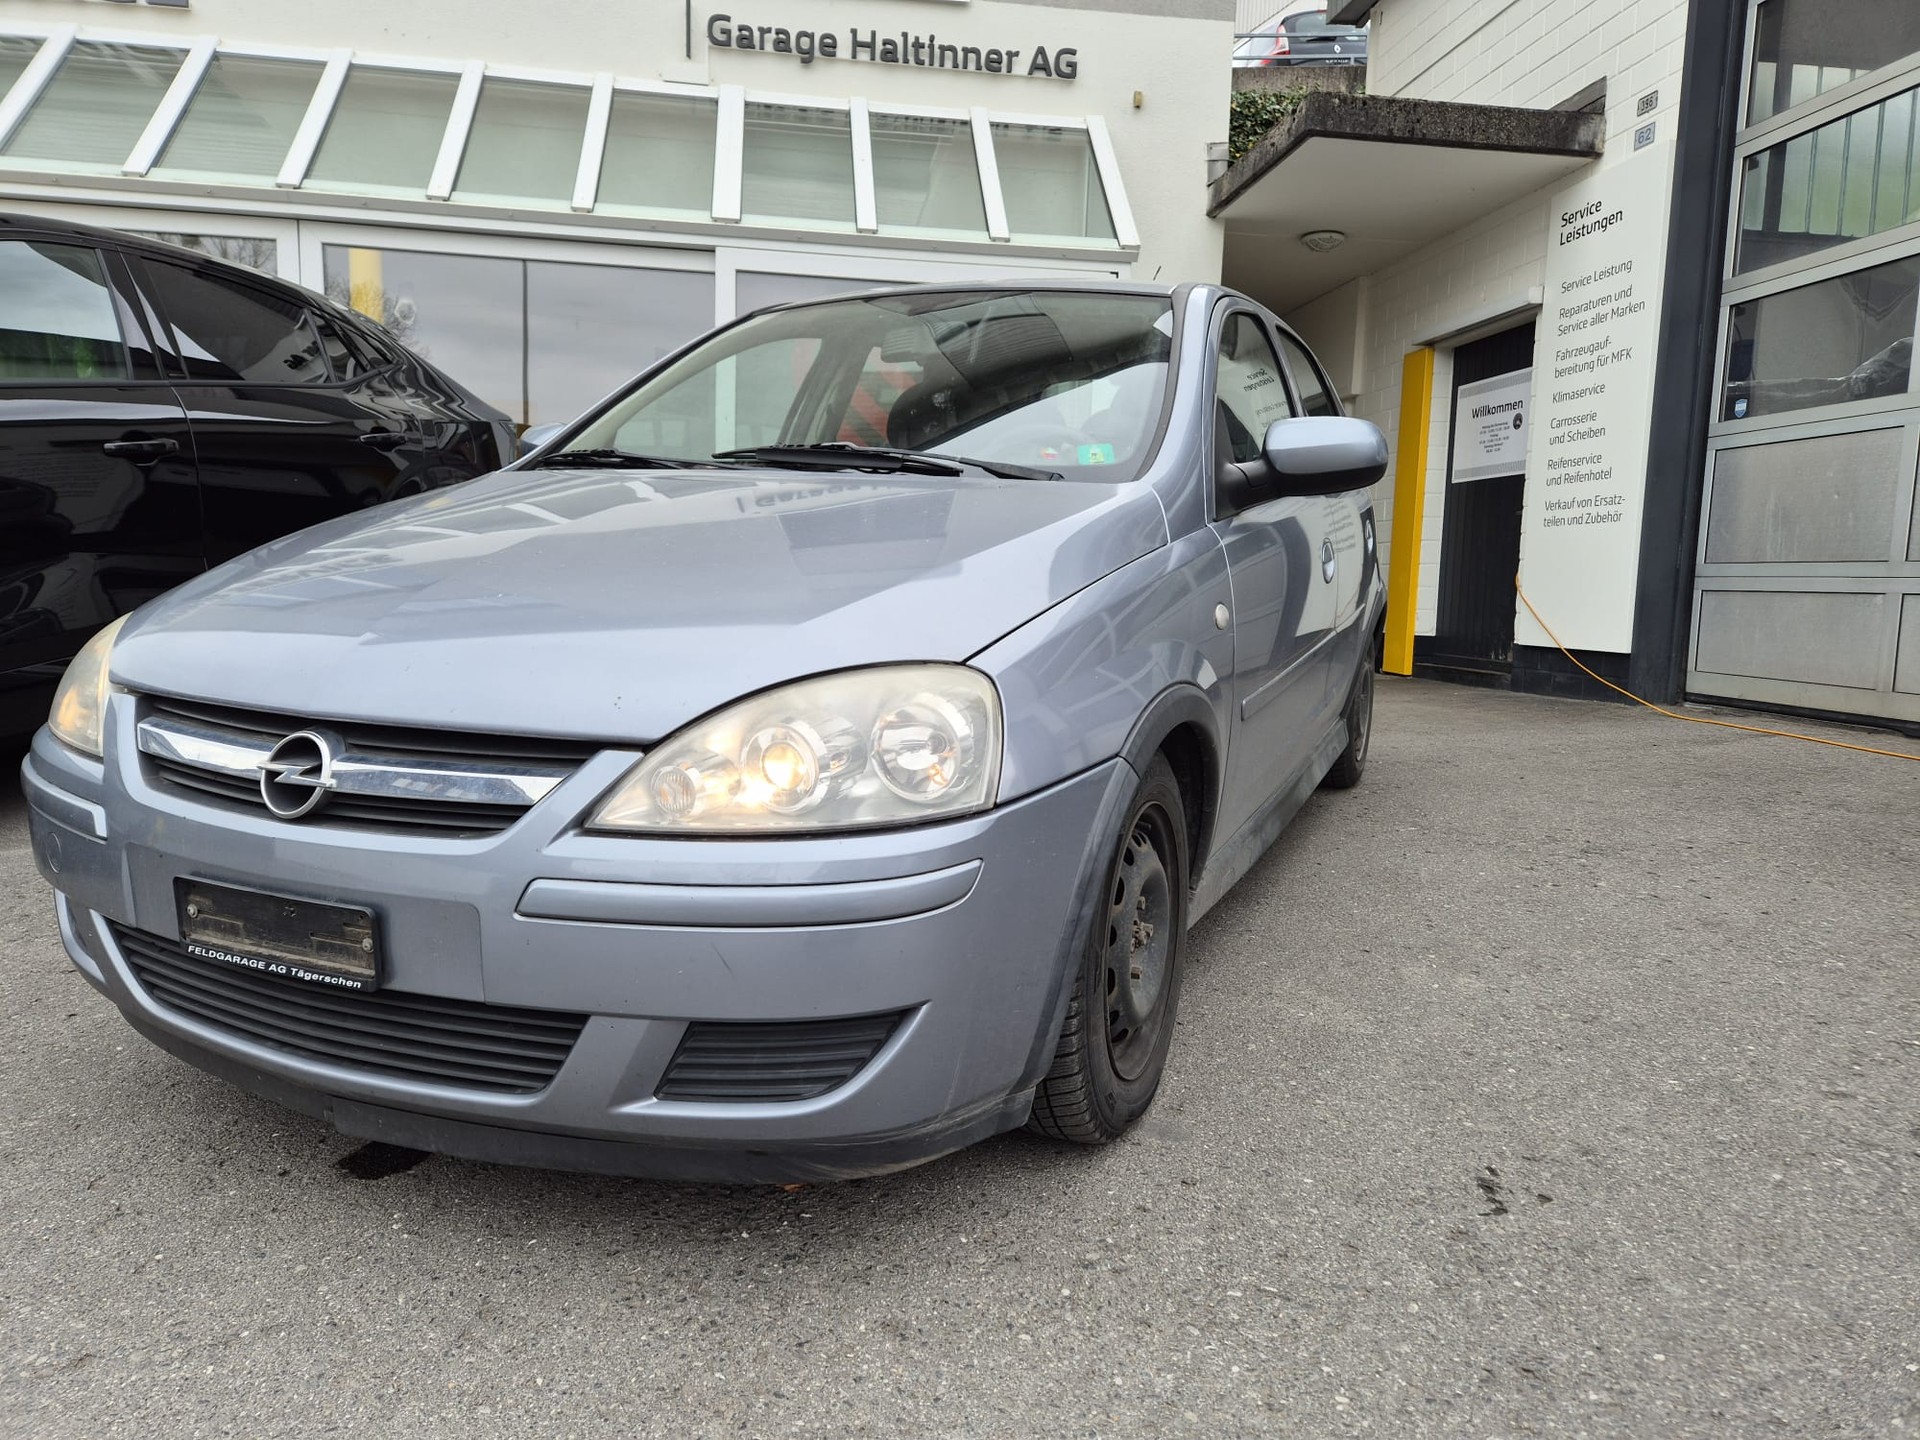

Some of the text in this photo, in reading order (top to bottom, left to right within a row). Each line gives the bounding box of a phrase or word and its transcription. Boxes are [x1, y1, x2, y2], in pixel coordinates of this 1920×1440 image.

[706, 13, 1078, 80] Garage Haltinner AG
[1638, 127, 1651, 144] 62
[1561, 200, 1602, 228] Service
[1559, 210, 1623, 246] Leistungen
[1561, 259, 1633, 294] Service Leistung
[1559, 285, 1633, 320] Reparaturen und
[1558, 300, 1646, 337] Service aller Marken
[1555, 335, 1612, 362] Fahrzeugauf-
[1554, 347, 1633, 379] bereitung für MFK
[1552, 383, 1606, 404] Klimaservice
[1471, 400, 1524, 419] Willkommen
[1550, 410, 1598, 429] Carrosserie
[1549, 426, 1606, 446] und Scheiben
[1547, 453, 1603, 471] Reifenservice
[1546, 467, 1612, 487] und Reifenhotel
[1544, 494, 1626, 512] Verkauf von Ersatz-
[1543, 511, 1623, 528] teilen und Zubehör
[187, 945, 362, 989] FELDGARAGE AG Tägerschen
